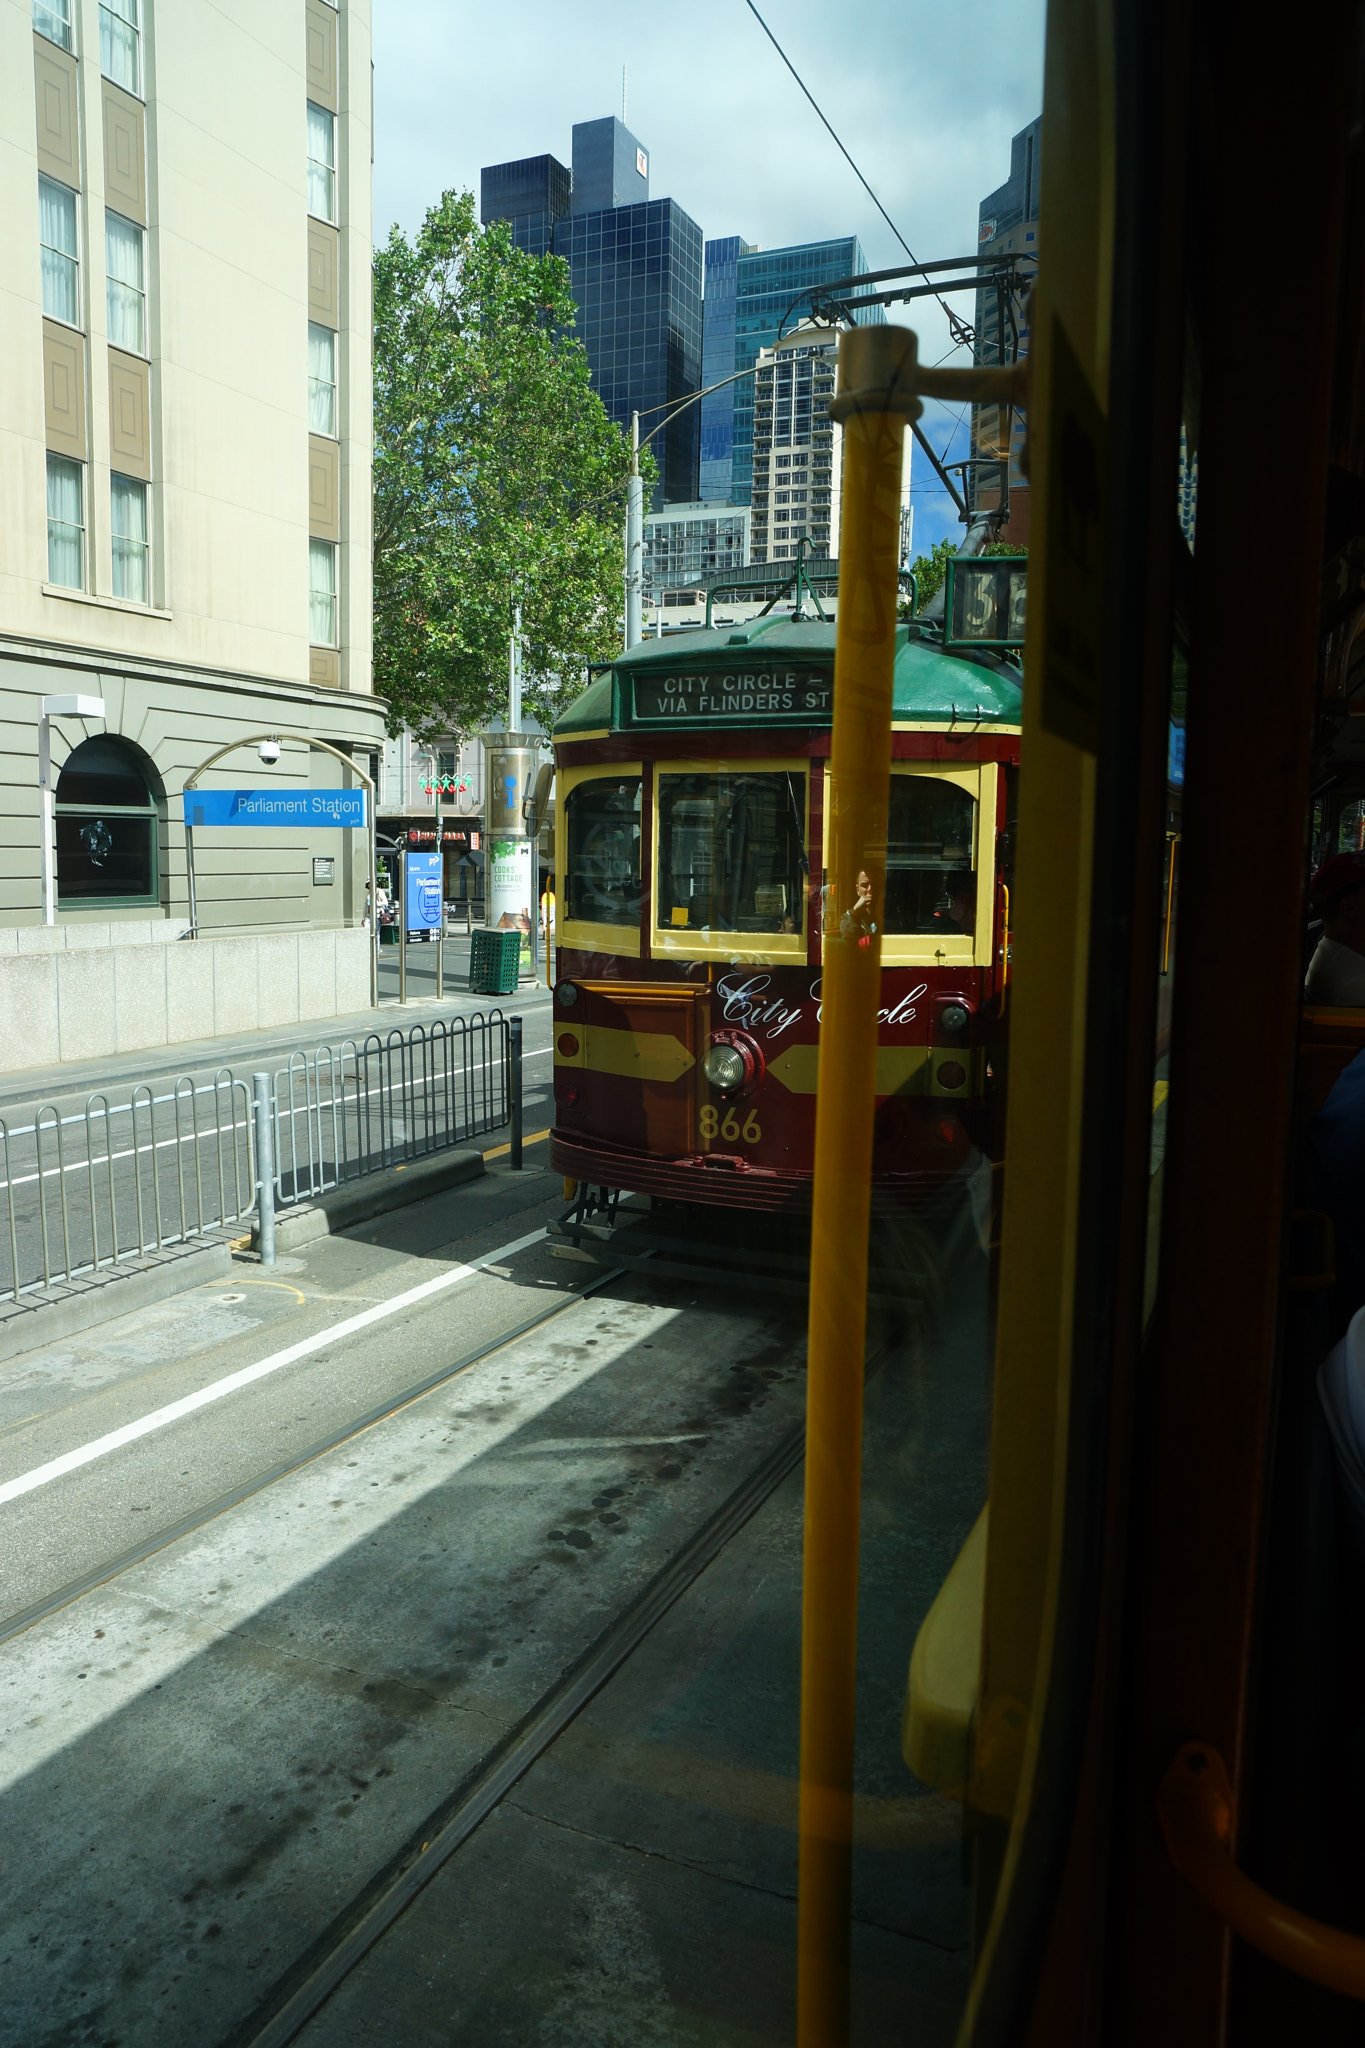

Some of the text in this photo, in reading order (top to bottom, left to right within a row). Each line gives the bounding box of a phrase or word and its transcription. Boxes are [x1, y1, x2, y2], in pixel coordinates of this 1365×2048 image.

[664, 676, 709, 693] CITY
[722, 673, 796, 691] CIRCLE
[657, 692, 830, 713] VIA FLINDERS ST
[238, 797, 360, 813] Parliament Station
[416, 878, 441, 887] Parliament
[494, 874, 523, 882] COTTAGE
[424, 887, 441, 895] Station
[716, 973, 803, 1039] City
[699, 1104, 762, 1144] 866
